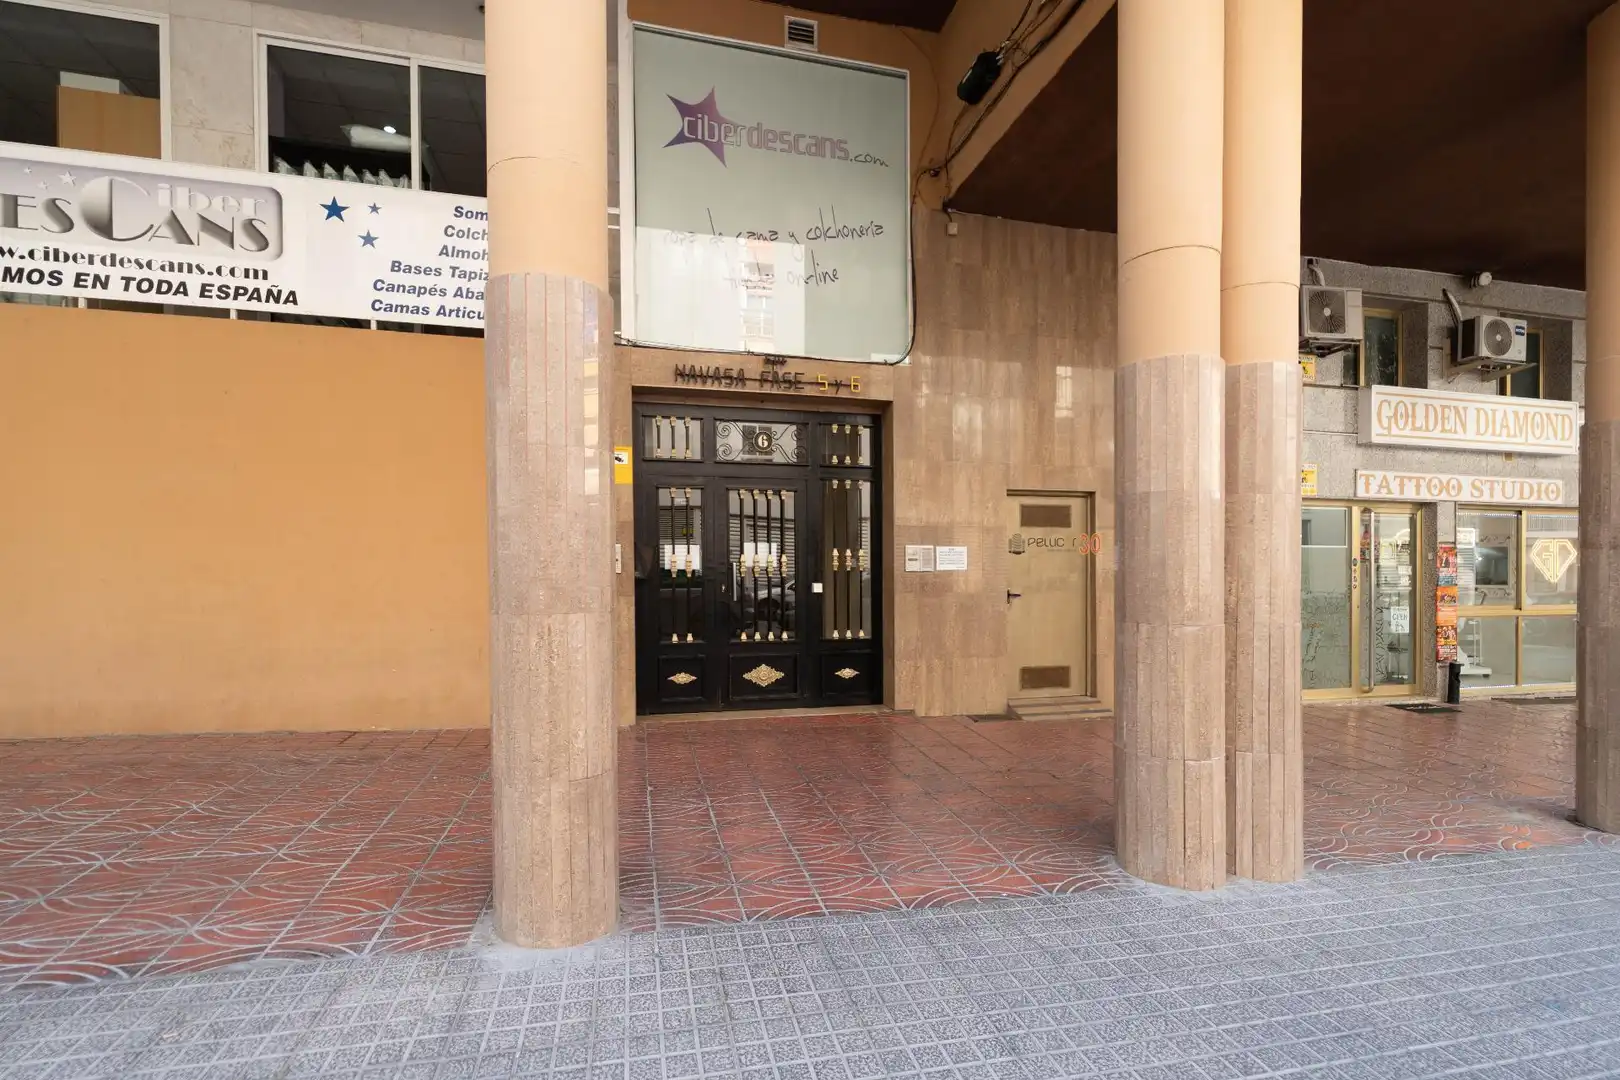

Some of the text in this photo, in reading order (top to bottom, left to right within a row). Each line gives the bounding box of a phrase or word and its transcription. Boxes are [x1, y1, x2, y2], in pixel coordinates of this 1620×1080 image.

[390, 260, 442, 277] Bases
[73, 272, 111, 290] EN
[120, 276, 189, 297] TODA
[199, 284, 299, 306] ESPAÑA
[372, 279, 447, 297] Canapés
[370, 299, 430, 316] Camas
[674, 363, 861, 394] NAVASA FASE 5 y 6
[1376, 398, 1574, 444] GOLDEN DIAMOND
[757, 434, 769, 448] 6
[1359, 473, 1561, 501] TATTOO STUDIO
[1079, 532, 1101, 555] 30
